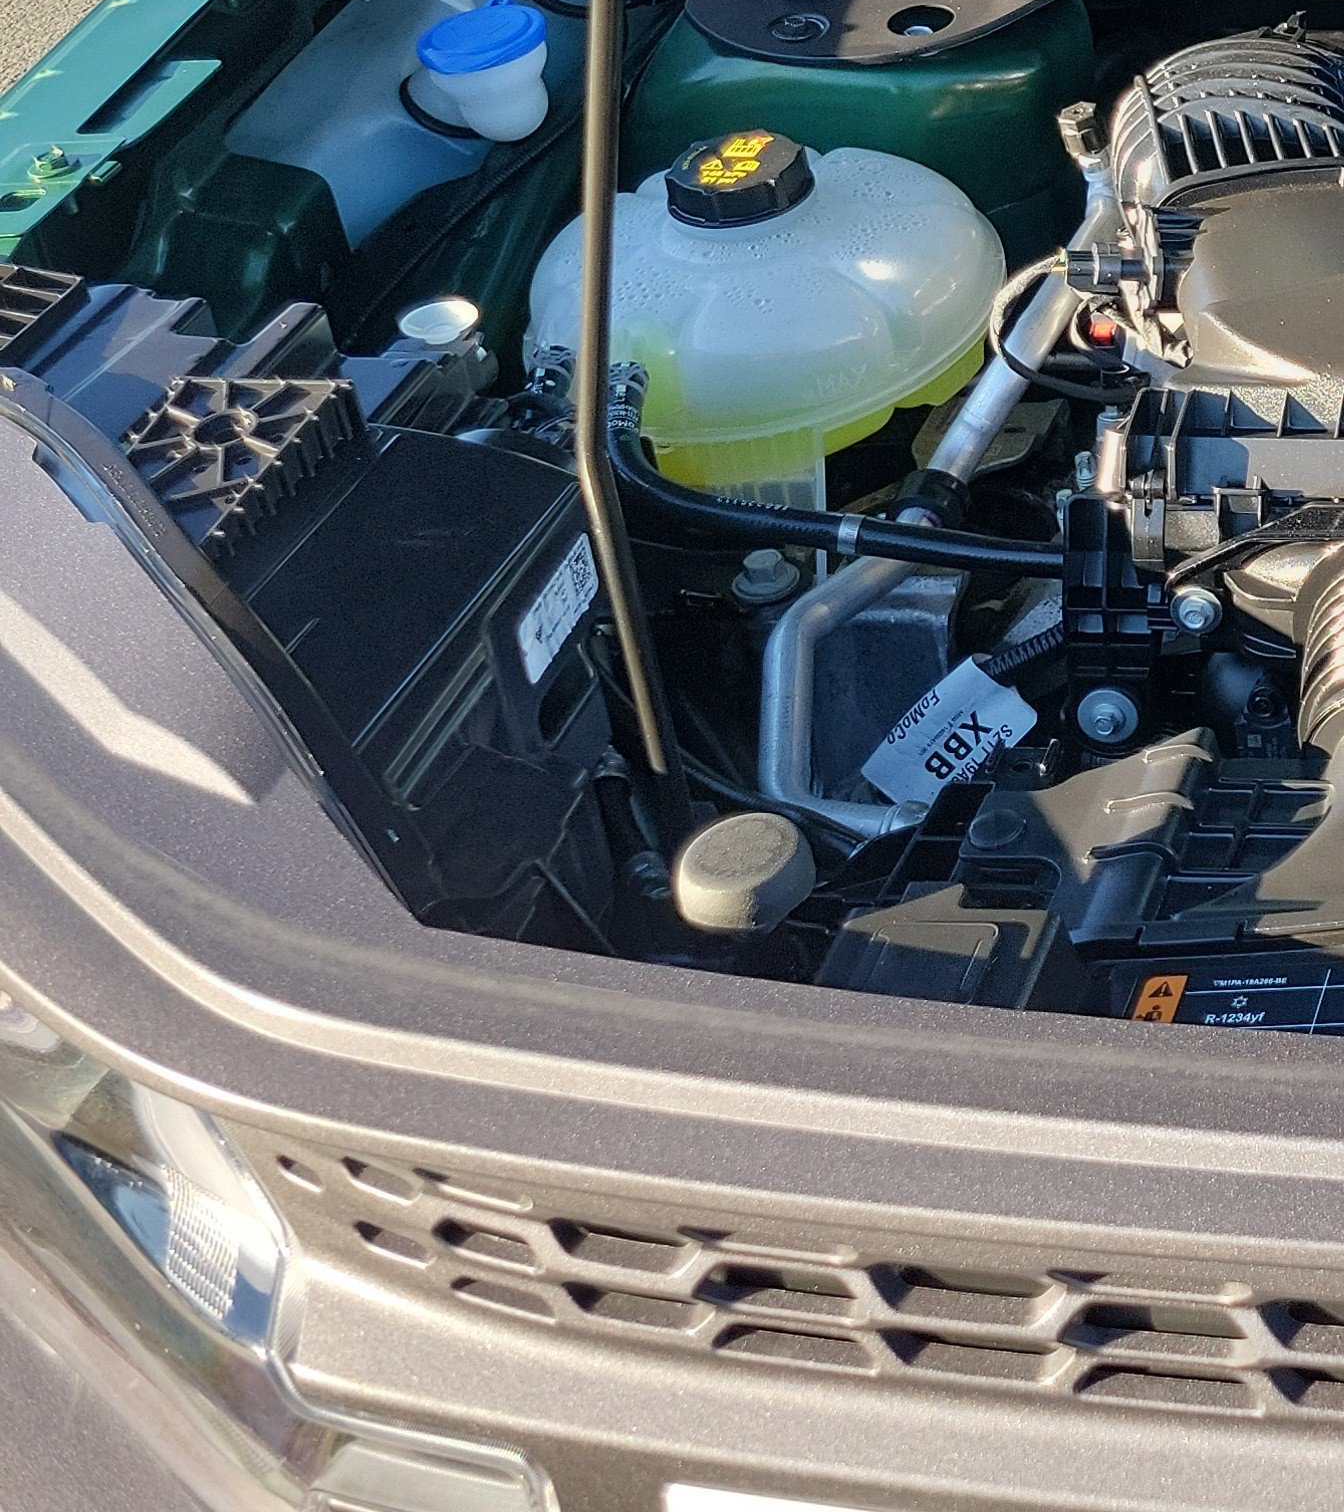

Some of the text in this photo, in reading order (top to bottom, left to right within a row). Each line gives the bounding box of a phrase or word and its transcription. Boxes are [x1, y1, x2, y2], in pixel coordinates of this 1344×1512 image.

[887, 689, 941, 746] FoMoCo
[924, 710, 994, 780] XBB
[1204, 1012, 1266, 1024] R-1234yf
